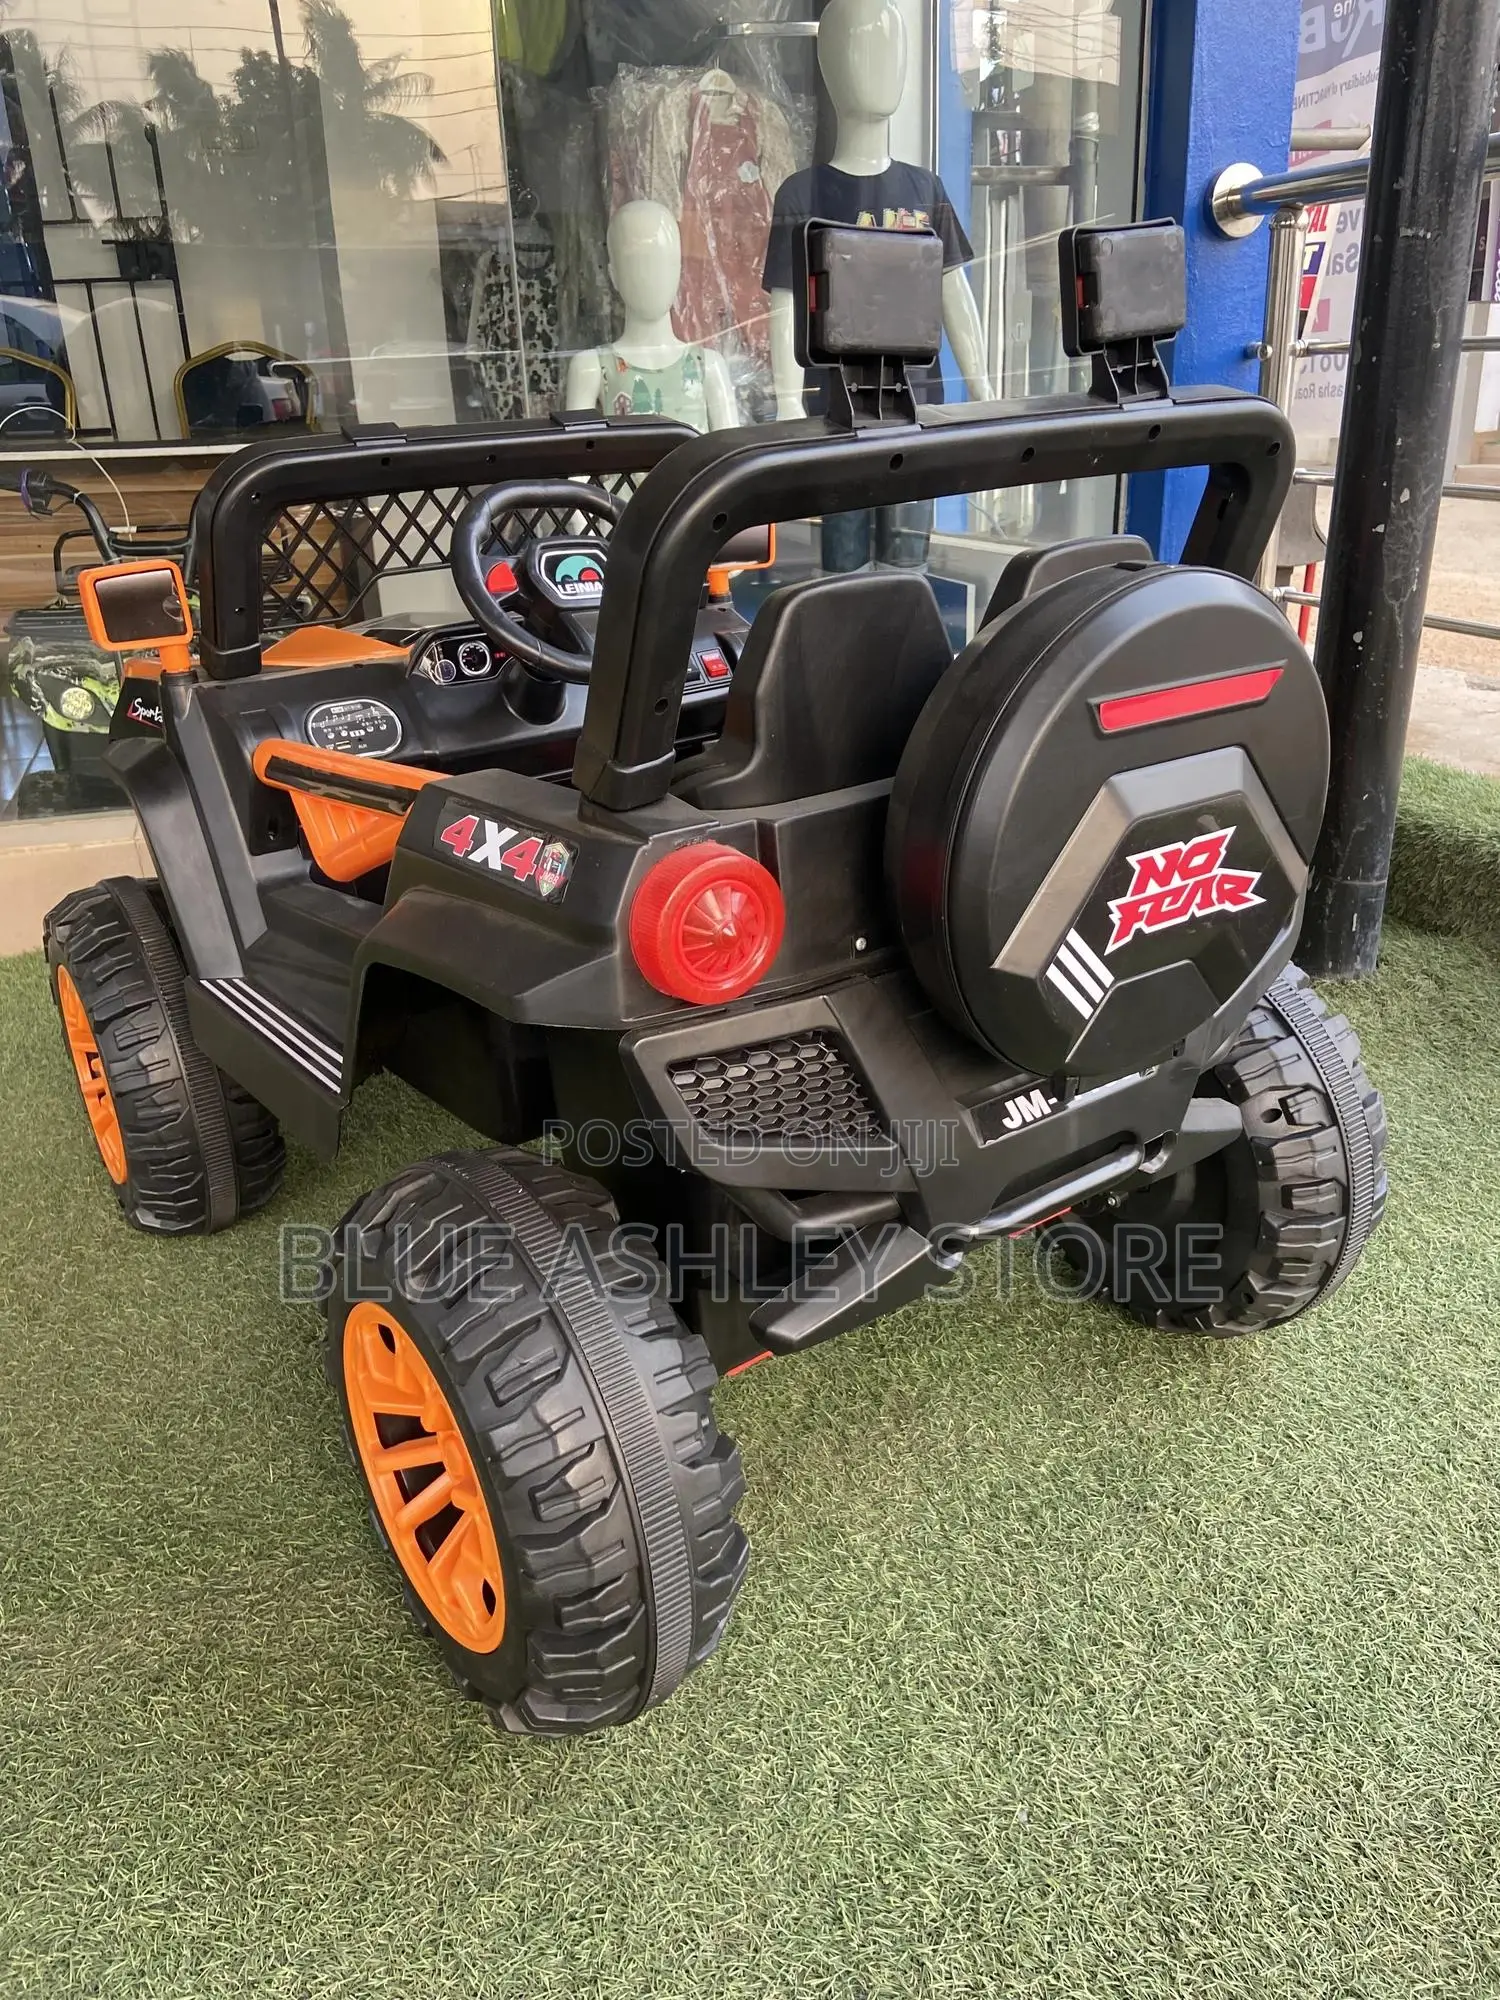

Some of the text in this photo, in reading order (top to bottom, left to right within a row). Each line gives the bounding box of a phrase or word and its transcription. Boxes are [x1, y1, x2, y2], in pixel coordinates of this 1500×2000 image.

[440, 814, 545, 882] 4X4
[1127, 828, 1233, 897] NO
[1107, 870, 1262, 951] FEAR
